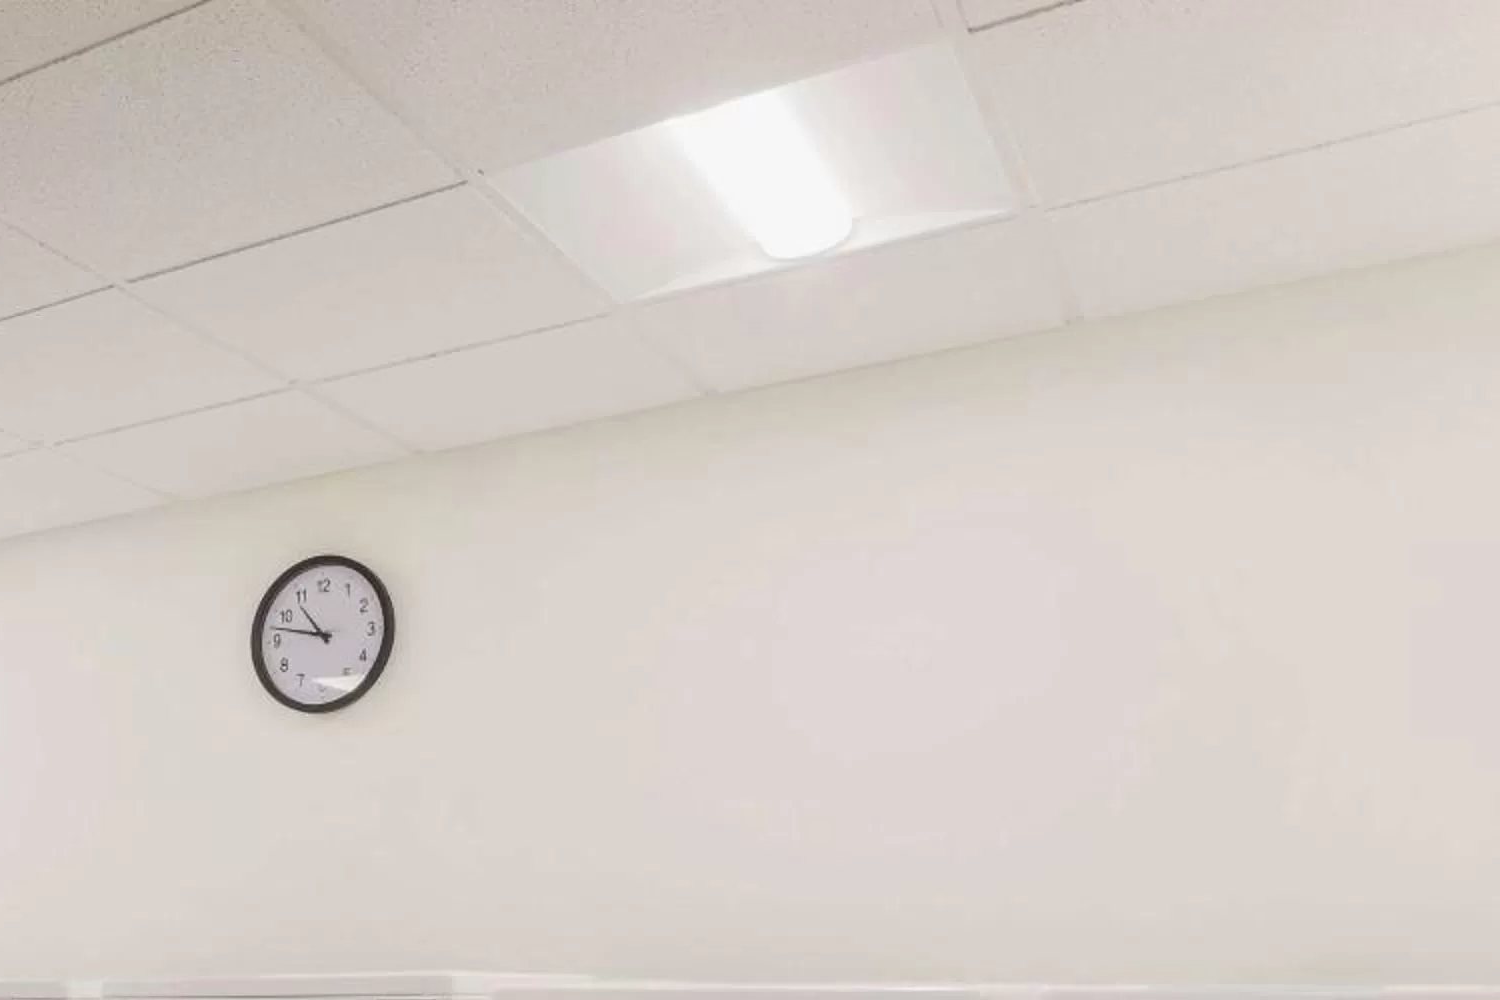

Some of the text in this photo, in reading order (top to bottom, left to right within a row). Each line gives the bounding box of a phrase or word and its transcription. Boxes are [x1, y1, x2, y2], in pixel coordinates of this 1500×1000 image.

[317, 577, 331, 593] 12
[345, 583, 351, 598] 1
[296, 589, 307, 604] 11
[359, 598, 369, 613] 2
[280, 609, 293, 624] 10
[367, 621, 376, 637] 3
[273, 633, 282, 649] 9
[359, 648, 368, 662] 4
[280, 657, 289, 673] 8
[296, 673, 305, 687] 7
